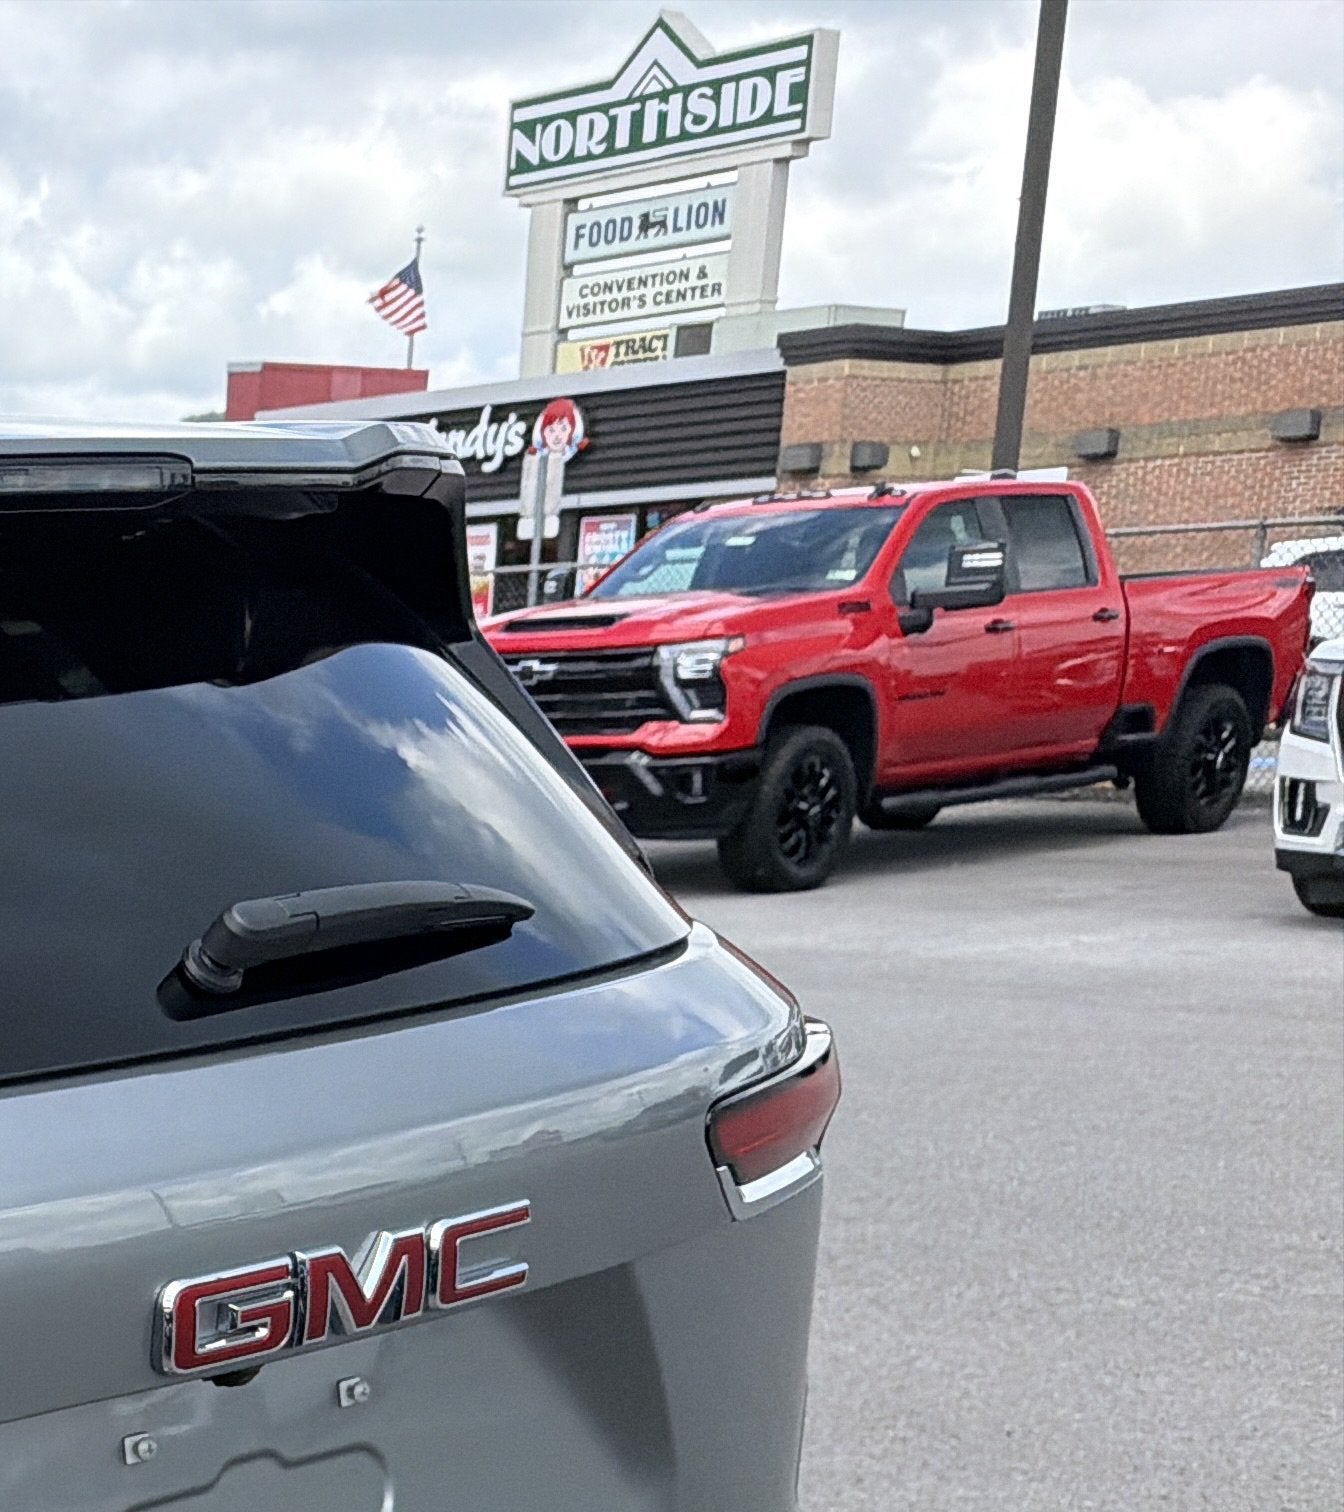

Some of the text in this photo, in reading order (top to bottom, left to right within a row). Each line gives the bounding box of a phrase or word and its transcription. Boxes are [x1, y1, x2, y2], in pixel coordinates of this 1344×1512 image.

[513, 66, 806, 169] NORTHSIDE
[573, 198, 727, 250] FOOD LION
[566, 281, 723, 319] VISITOR'S CENTER
[578, 264, 709, 299] CONVENTION &
[151, 1198, 531, 1376] GMC
